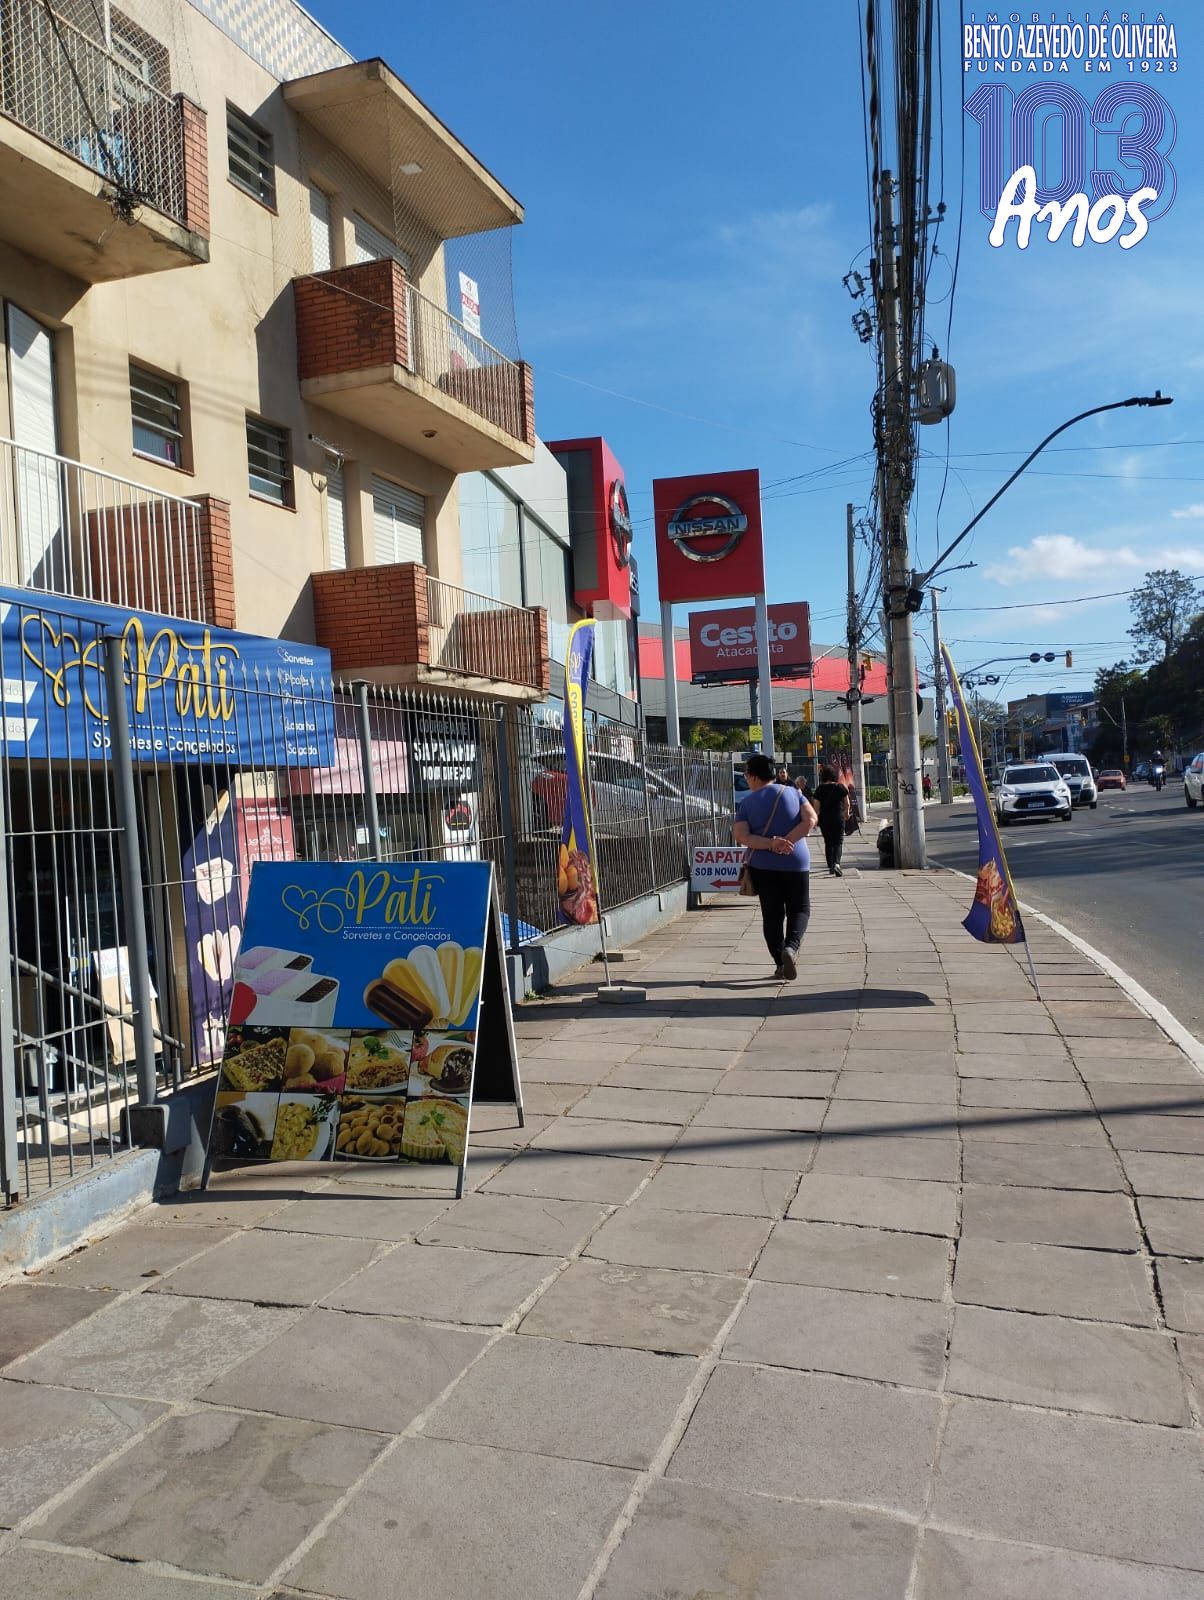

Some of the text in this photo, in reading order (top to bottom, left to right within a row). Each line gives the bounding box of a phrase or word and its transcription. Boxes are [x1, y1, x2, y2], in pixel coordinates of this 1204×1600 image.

[674, 518, 739, 536] NISSAN
[716, 643, 784, 658] Atacata
[122, 617, 240, 721] Pati
[92, 731, 236, 755] Sotes e Congelados
[695, 867, 738, 876] SOB NOVA
[345, 869, 446, 925] Pati
[342, 930, 451, 942] Sorvetes e Congelados
